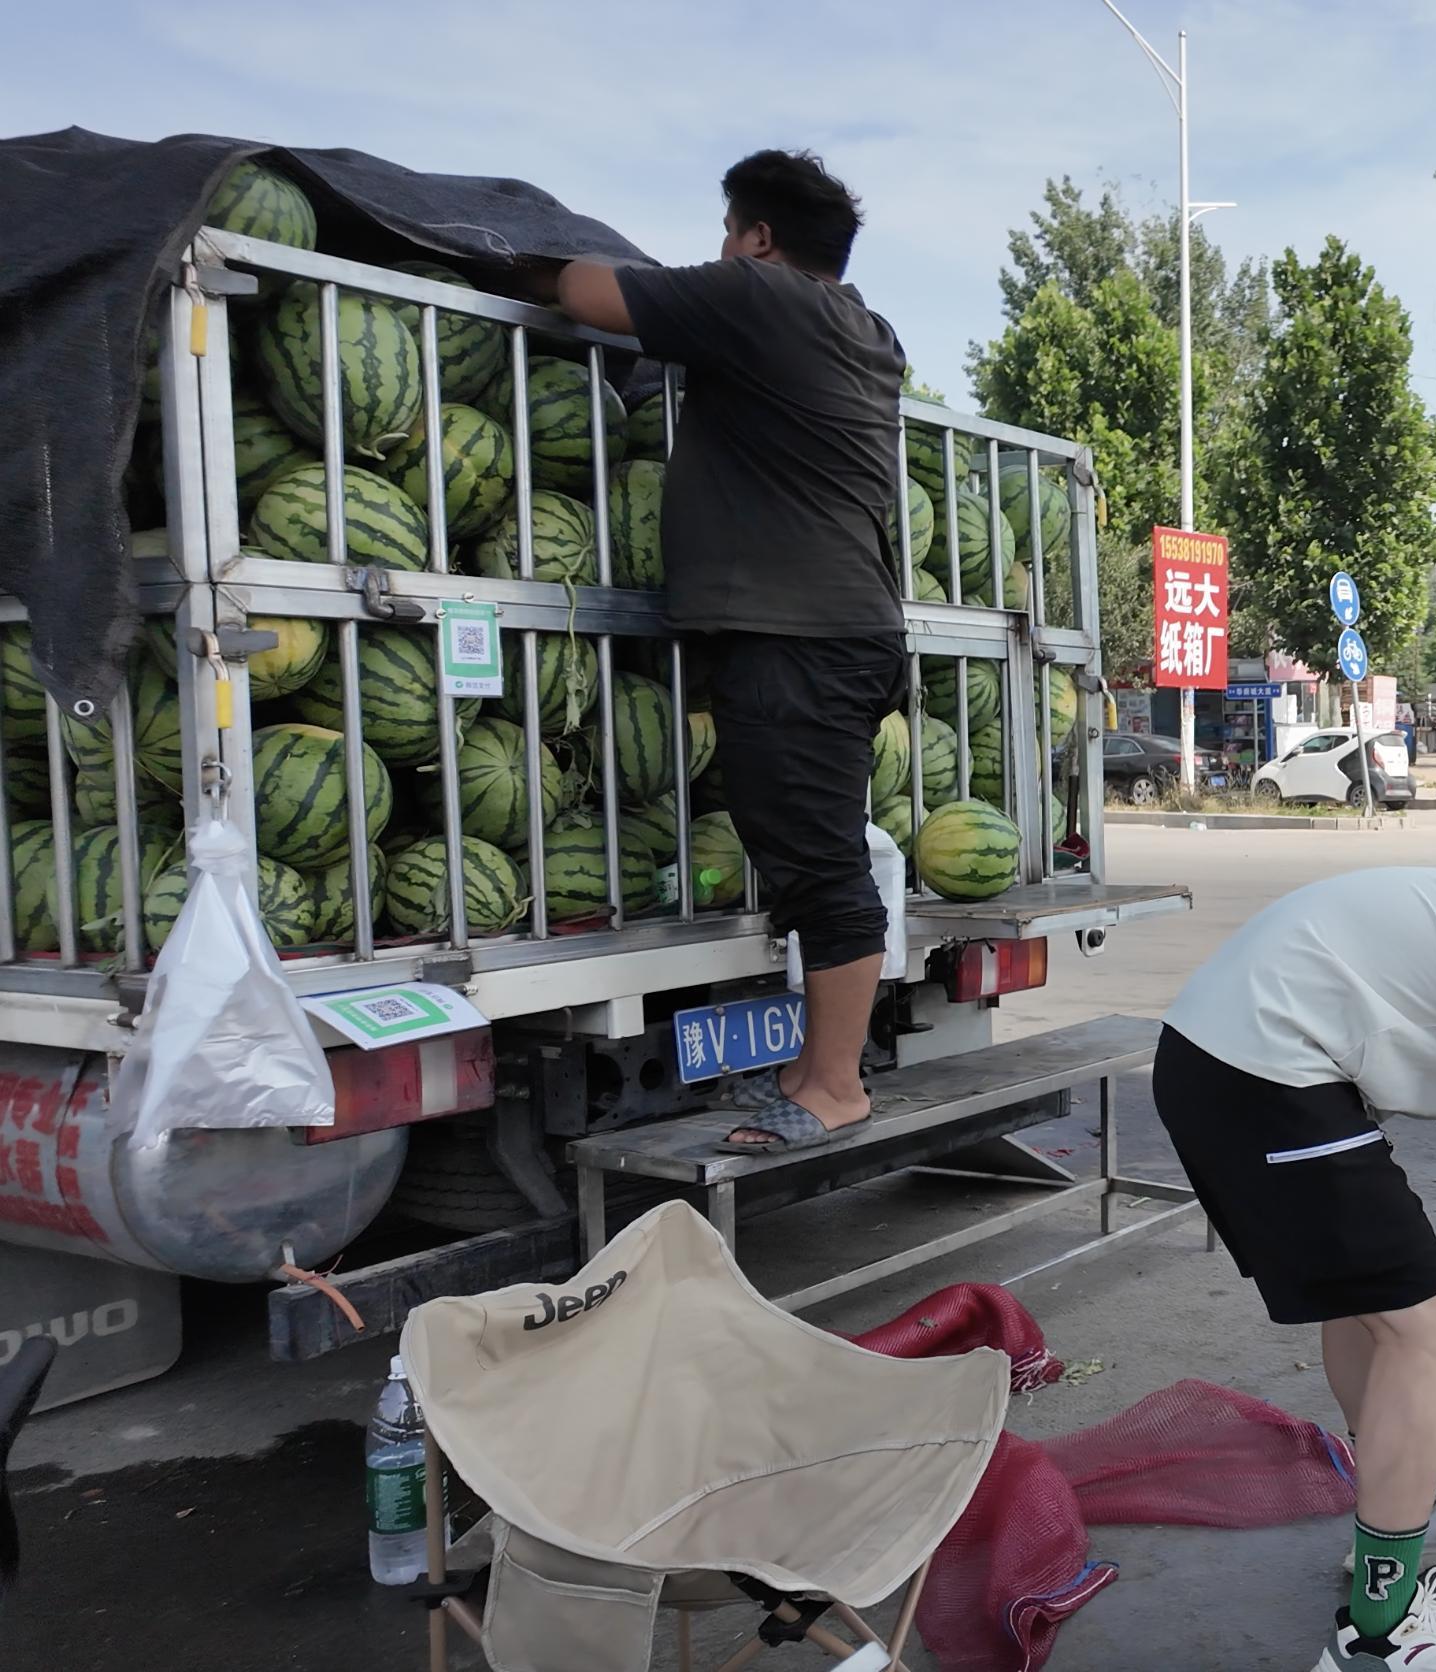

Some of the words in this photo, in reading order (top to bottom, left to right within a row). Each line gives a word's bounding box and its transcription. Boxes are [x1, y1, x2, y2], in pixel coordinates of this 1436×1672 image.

[1160, 533, 1224, 566] 15538191970
[1164, 568, 1220, 618] 远大
[1160, 620, 1225, 676] 纸箱厂
[682, 1001, 805, 1070] 豫V·1GX
[522, 1269, 628, 1332] Jeep
[1364, 1554, 1404, 1600] P
